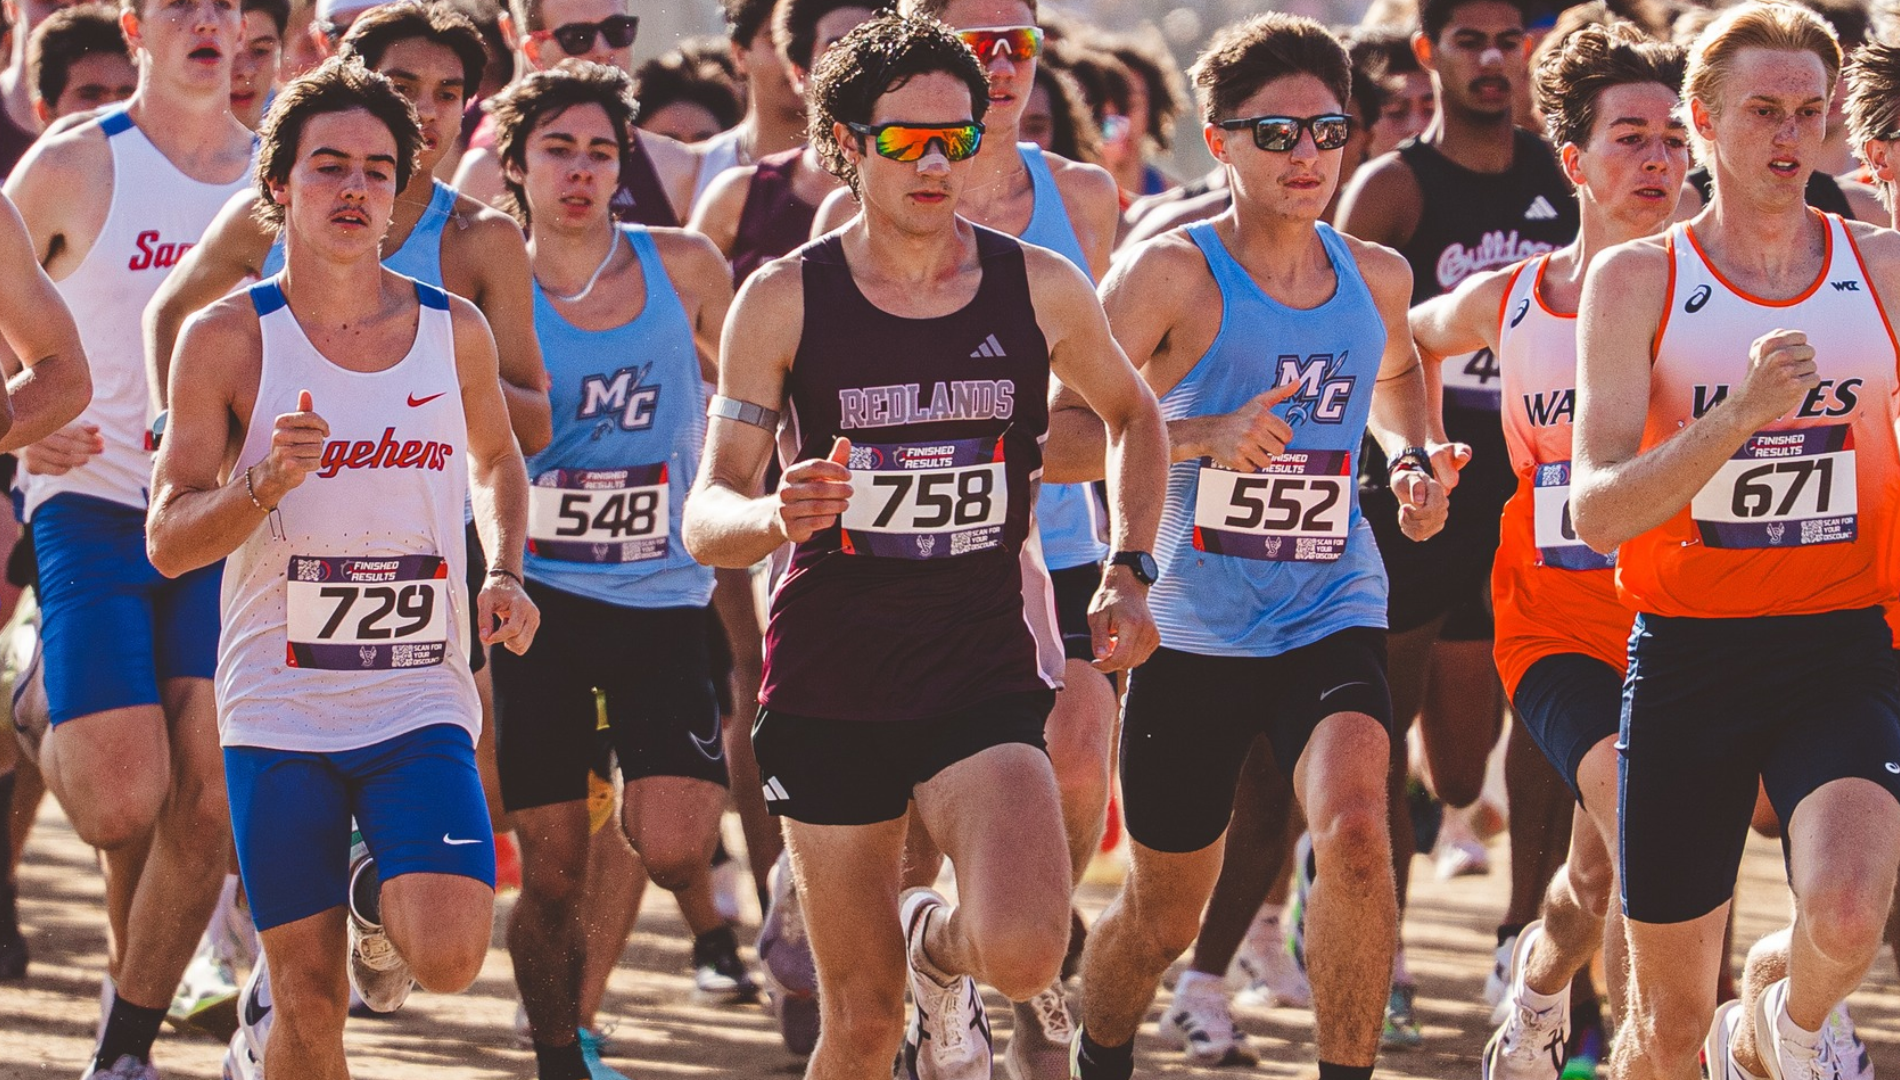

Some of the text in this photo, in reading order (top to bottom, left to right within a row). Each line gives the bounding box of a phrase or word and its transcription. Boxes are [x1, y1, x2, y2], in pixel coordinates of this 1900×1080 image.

[1271, 353, 1357, 424] MC
[575, 366, 661, 432] MC
[839, 380, 1015, 429] REDLANDS
[1693, 378, 1863, 420] WES
[1757, 434, 1805, 445] FINISHED
[907, 445, 955, 457] FINISHED
[1754, 446, 1802, 457] RESULTS
[904, 457, 953, 469] RESULTS
[1266, 453, 1309, 463] INISHED
[586, 470, 629, 480] FINISHED
[584, 479, 626, 489] RESULTS
[1731, 457, 1833, 518] 671
[872, 469, 993, 528] 758
[1225, 477, 1340, 531] 552
[556, 490, 659, 537] 548
[971, 526, 1001, 537] SCAN FOR
[971, 535, 988, 543] YOUR
[1316, 538, 1345, 546] SCAN FOR
[1316, 545, 1333, 553] YOUR
[353, 561, 399, 571] FINISHED
[351, 571, 396, 582] RESULTS
[317, 584, 435, 640] 729
[430, 643, 443, 651] FOR
